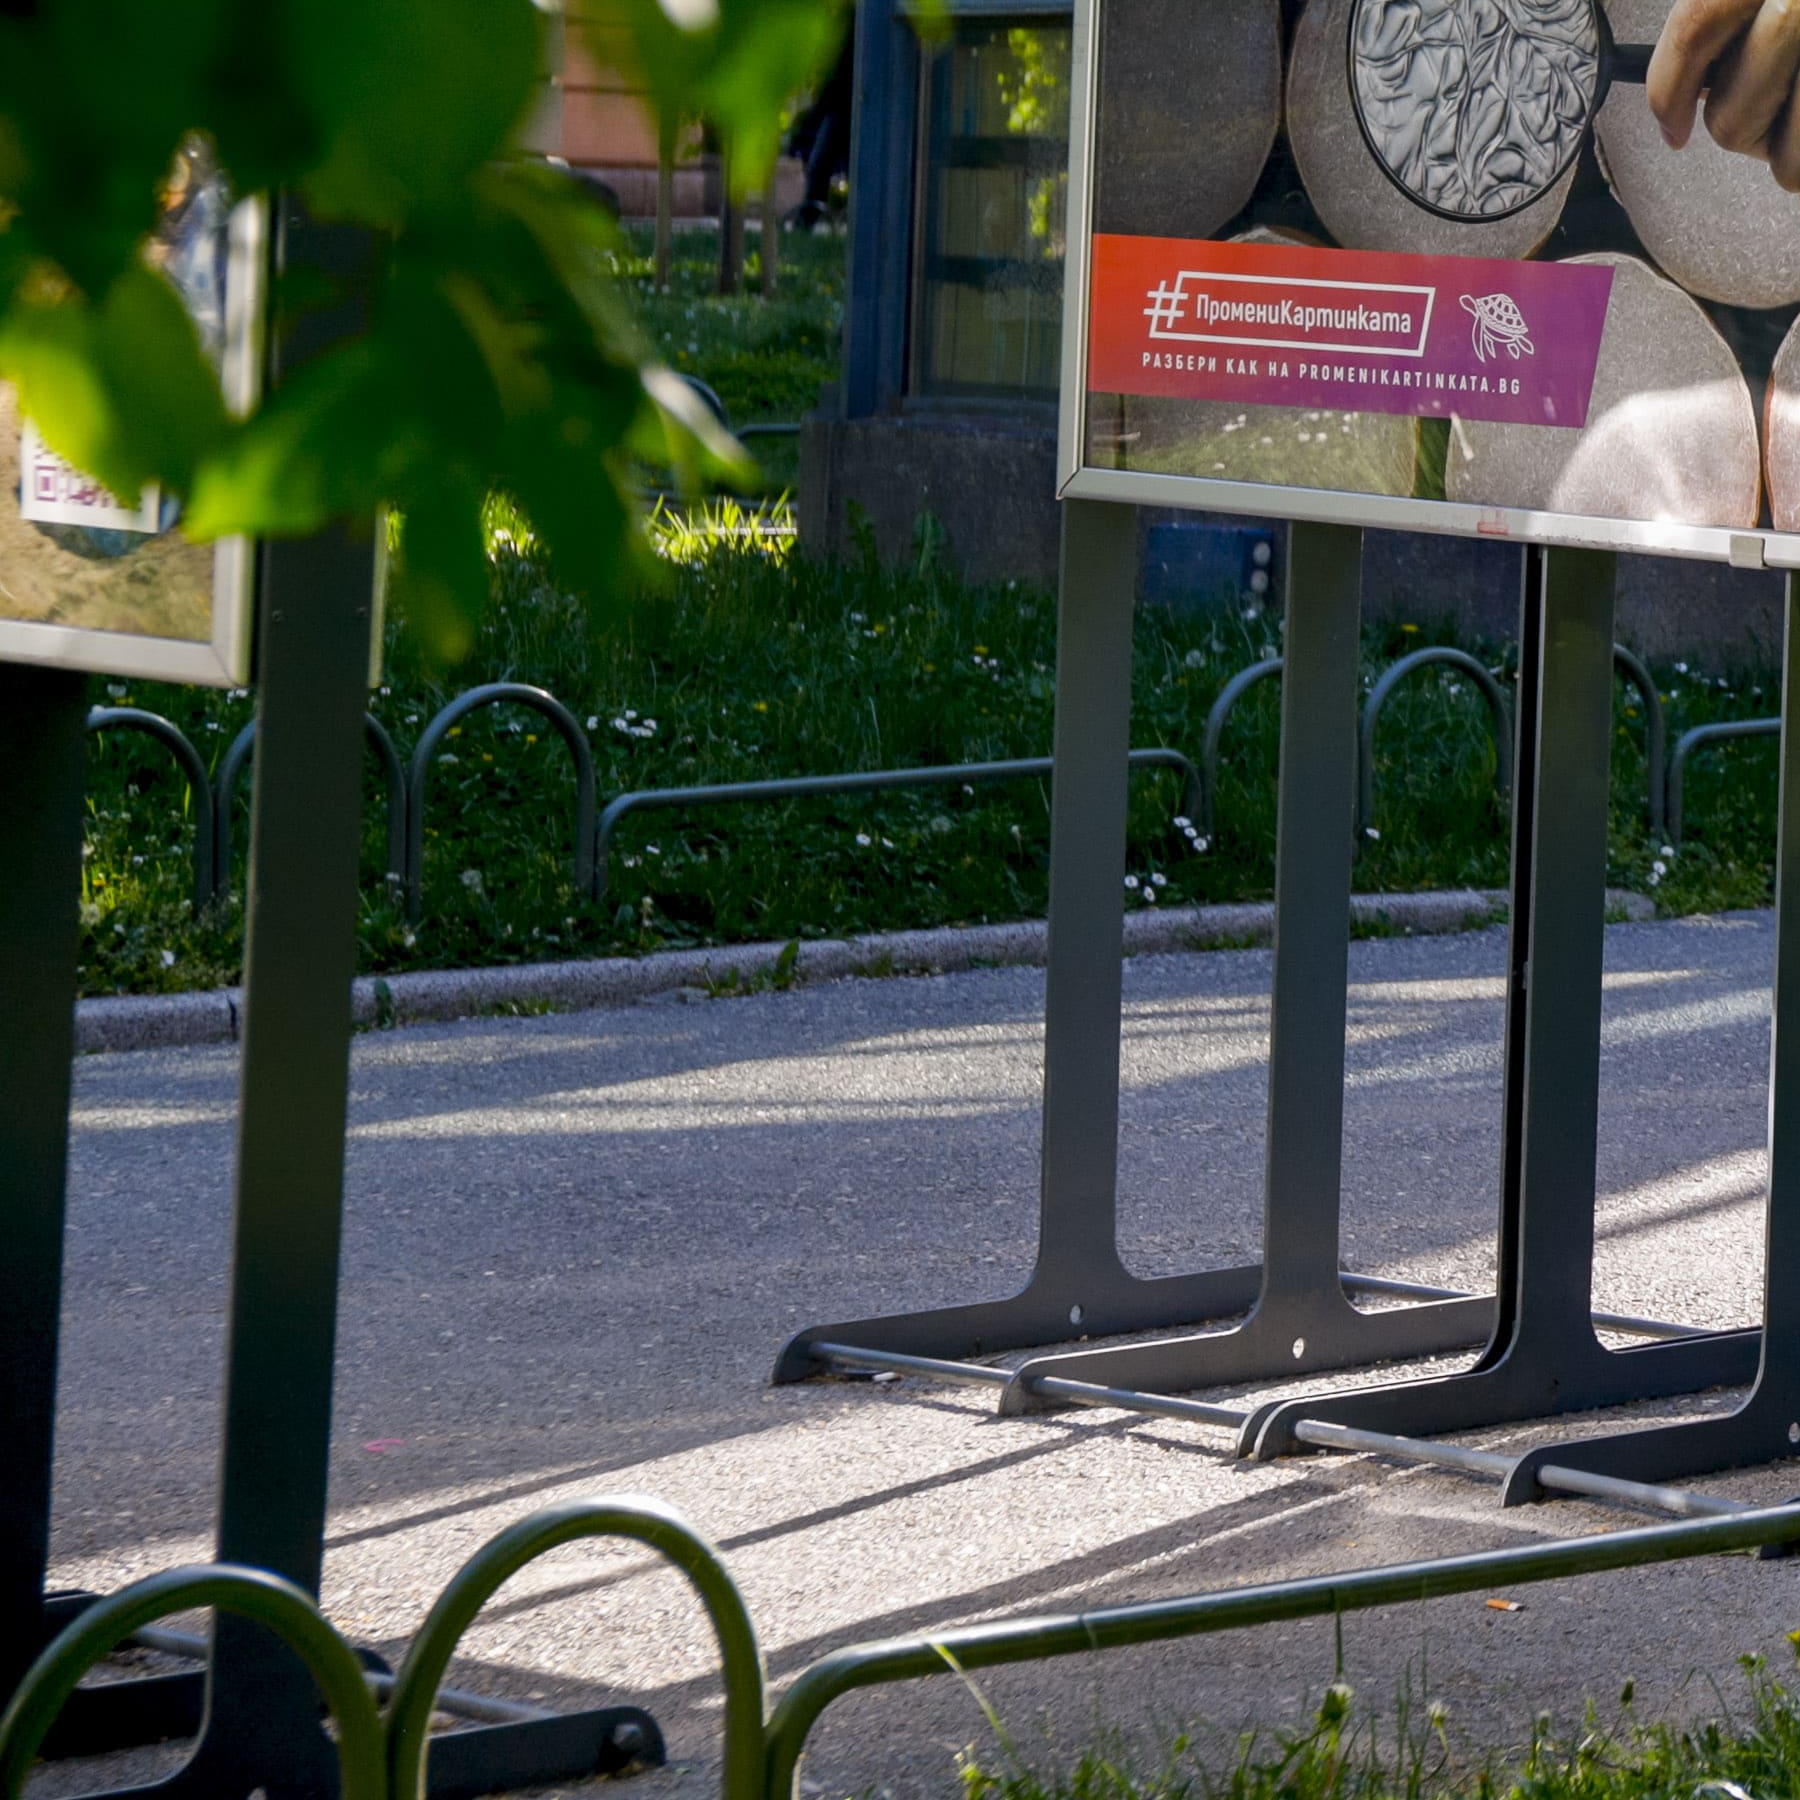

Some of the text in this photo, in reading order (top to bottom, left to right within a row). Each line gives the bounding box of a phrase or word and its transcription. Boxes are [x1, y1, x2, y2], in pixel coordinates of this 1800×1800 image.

[1142, 351, 1521, 395] РАЗБЕРИ КАК НА PROMENIKARTINKATA.BG
